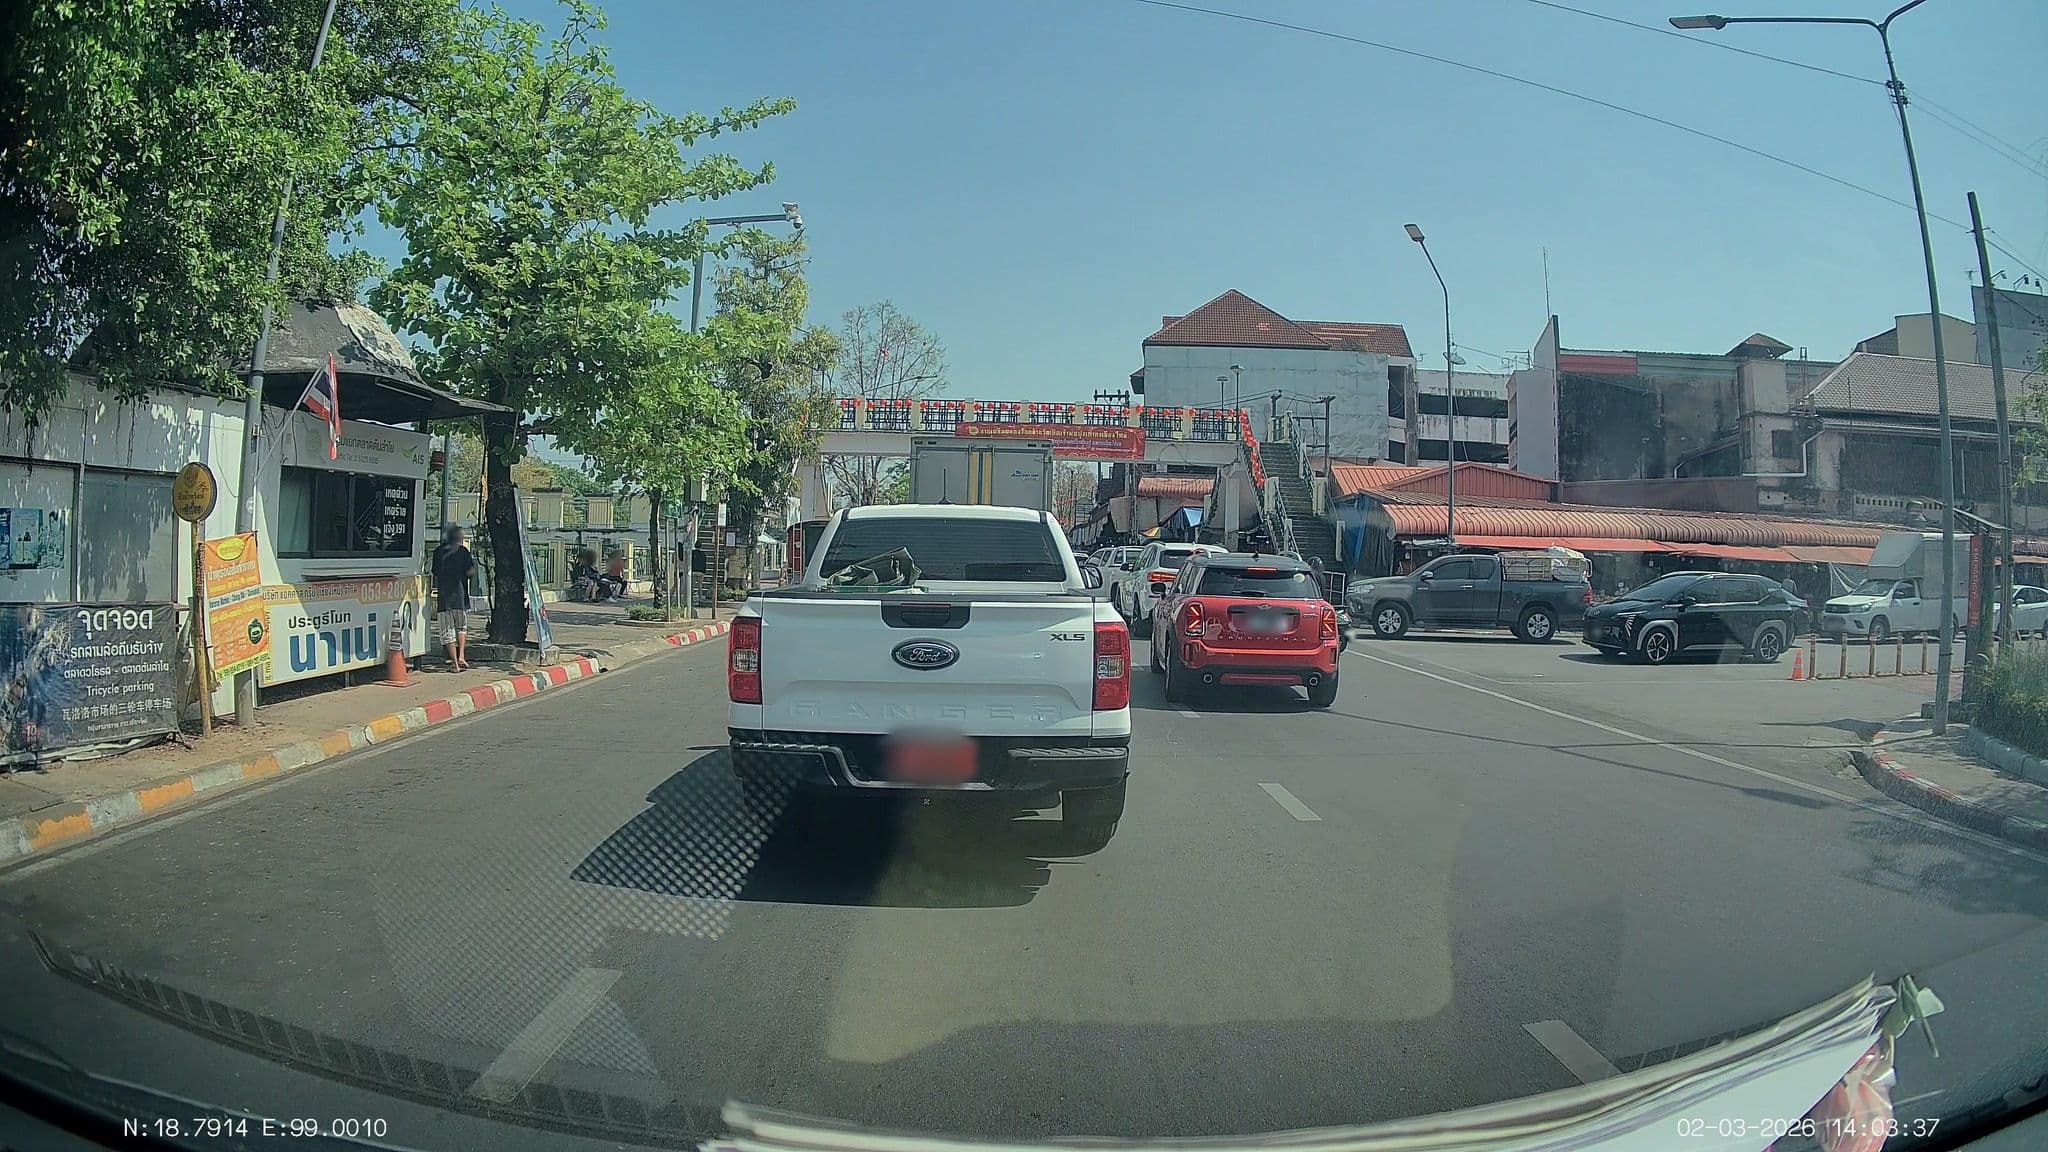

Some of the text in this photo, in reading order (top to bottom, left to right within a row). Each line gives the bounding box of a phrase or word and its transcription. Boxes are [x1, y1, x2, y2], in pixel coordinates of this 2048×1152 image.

[412, 454, 425, 465] AIS
[385, 486, 409, 502] เหตุด่วน
[384, 503, 407, 519] เหตุร้าย
[395, 523, 406, 534] 191
[77, 609, 153, 640] จุดจอด
[288, 609, 351, 629] ประตูรีโมท
[289, 612, 377, 673] นาเน่
[1049, 633, 1086, 642] XLS
[70, 640, 164, 659] รถสามล้อถีบรับจ้าง
[908, 647, 941, 663] Ford
[64, 664, 111, 679] ตลาดวโรรส
[86, 680, 155, 697] Tricycle parking
[62, 697, 172, 721] 瓦洛洛市场的三轮车停车场
[790, 702, 1063, 722] RANGER
[25, 725, 37, 737] 10
